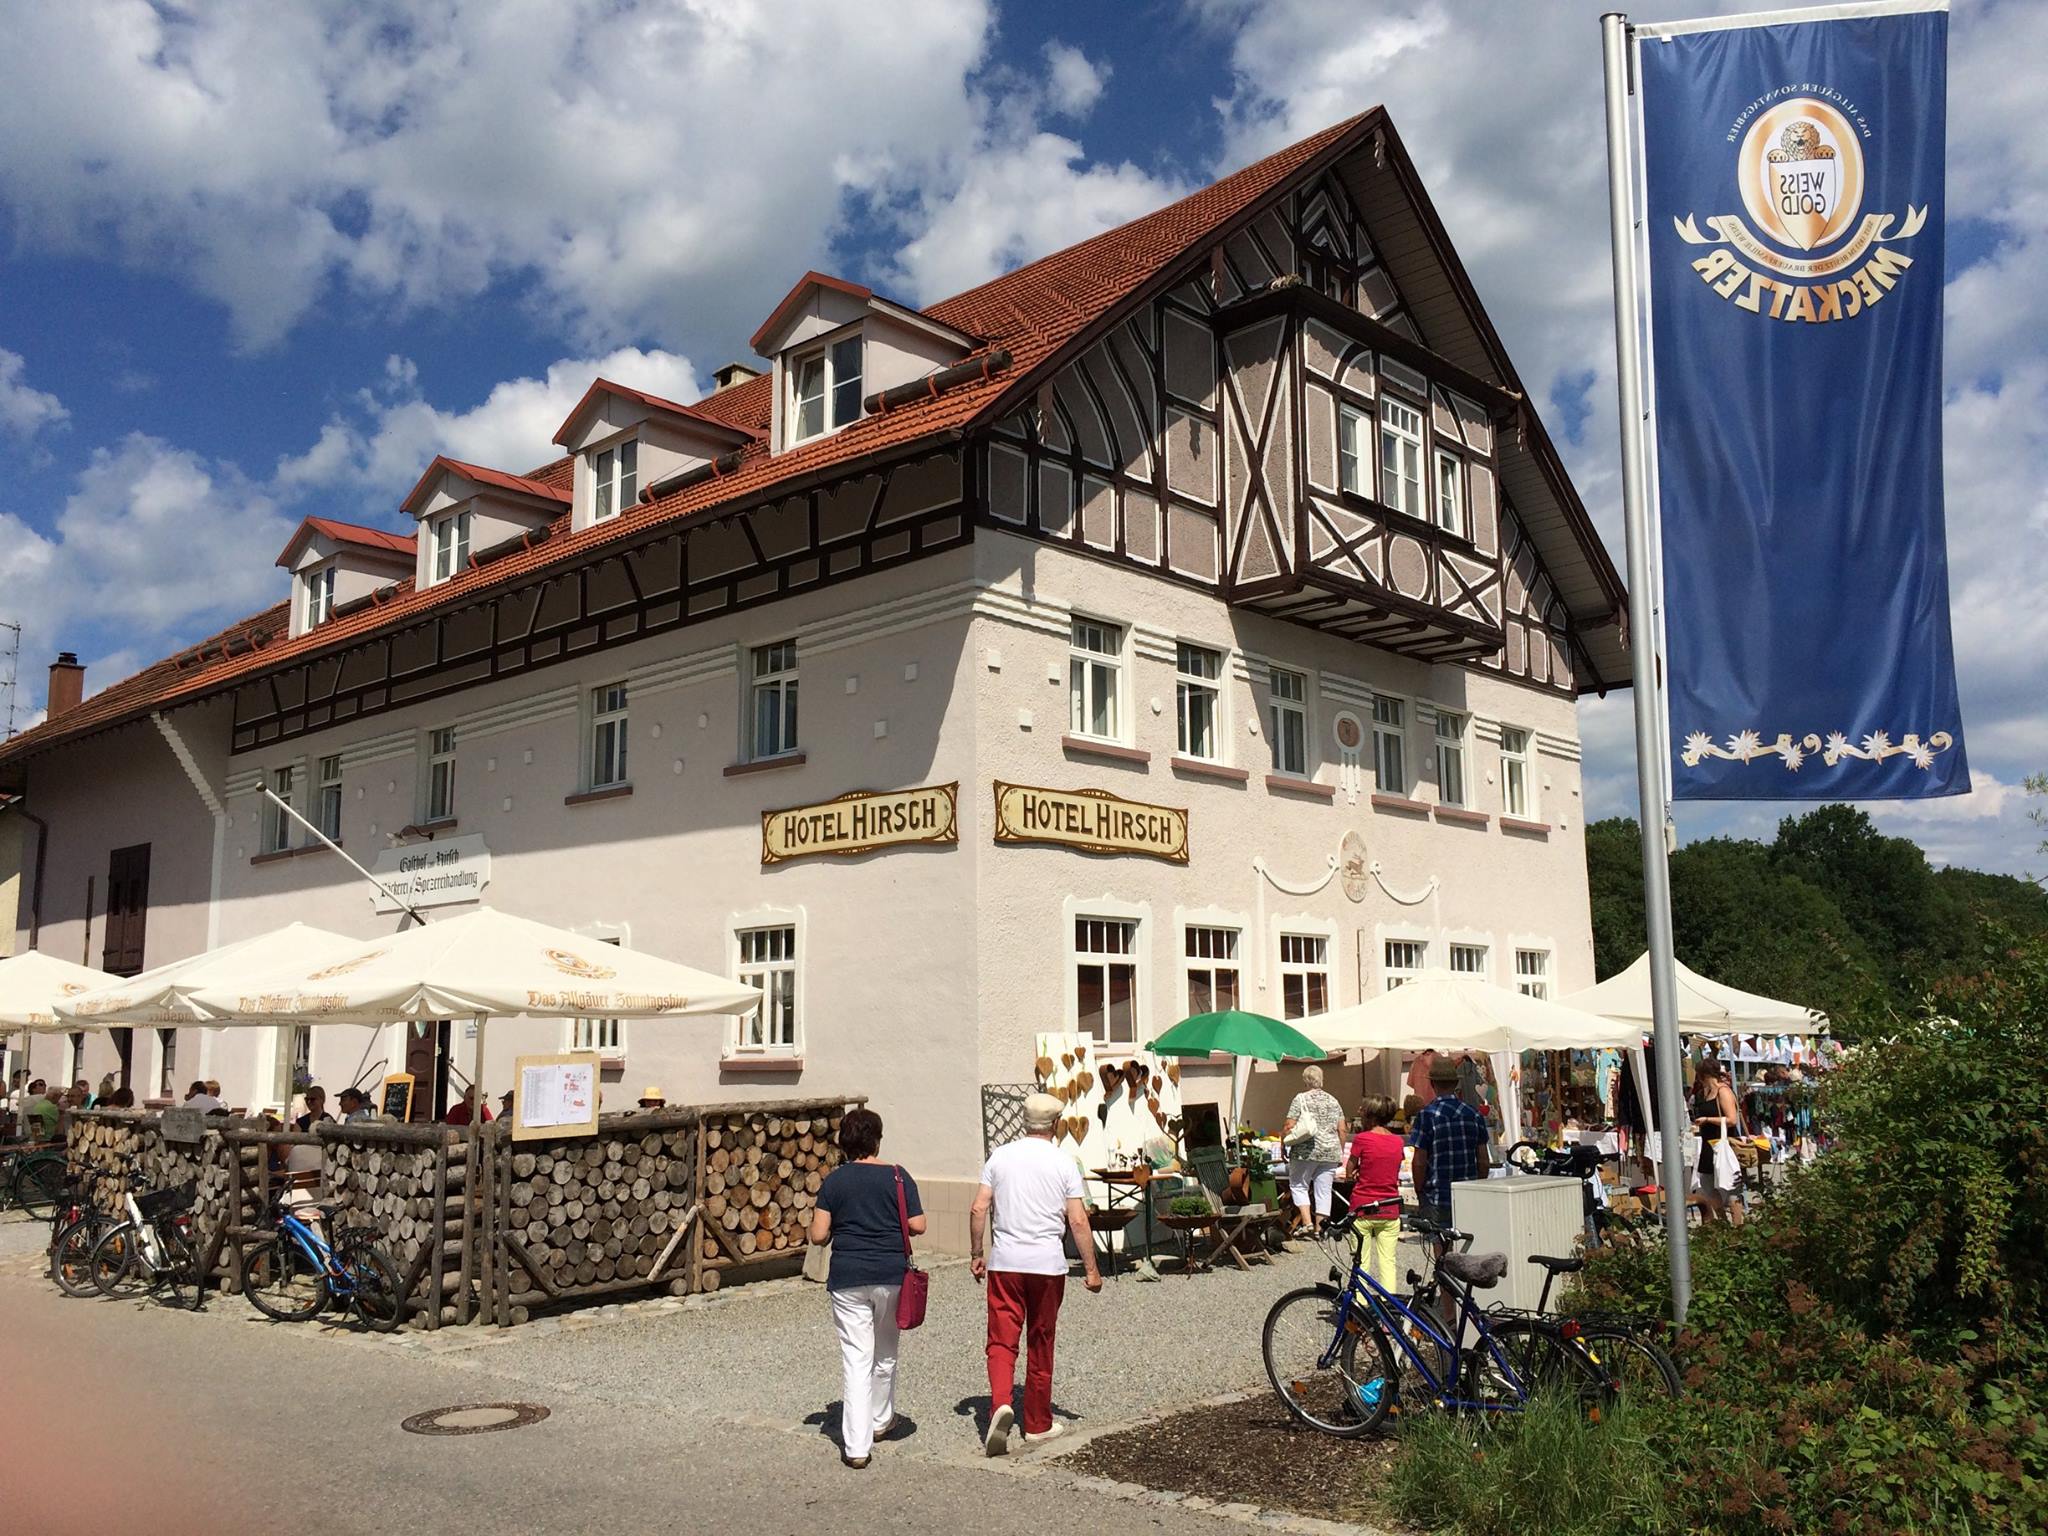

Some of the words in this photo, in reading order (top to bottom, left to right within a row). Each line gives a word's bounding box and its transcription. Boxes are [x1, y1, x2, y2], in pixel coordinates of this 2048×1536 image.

[784, 811, 849, 849] HOTEL
[852, 798, 936, 840] HIRSCH
[1022, 794, 1093, 835] HOTEL
[1096, 803, 1172, 845] HIRSCH
[527, 990, 556, 1008] Das
[559, 990, 609, 1010] Allgäuer
[615, 992, 689, 1011] Sonntagsbier
